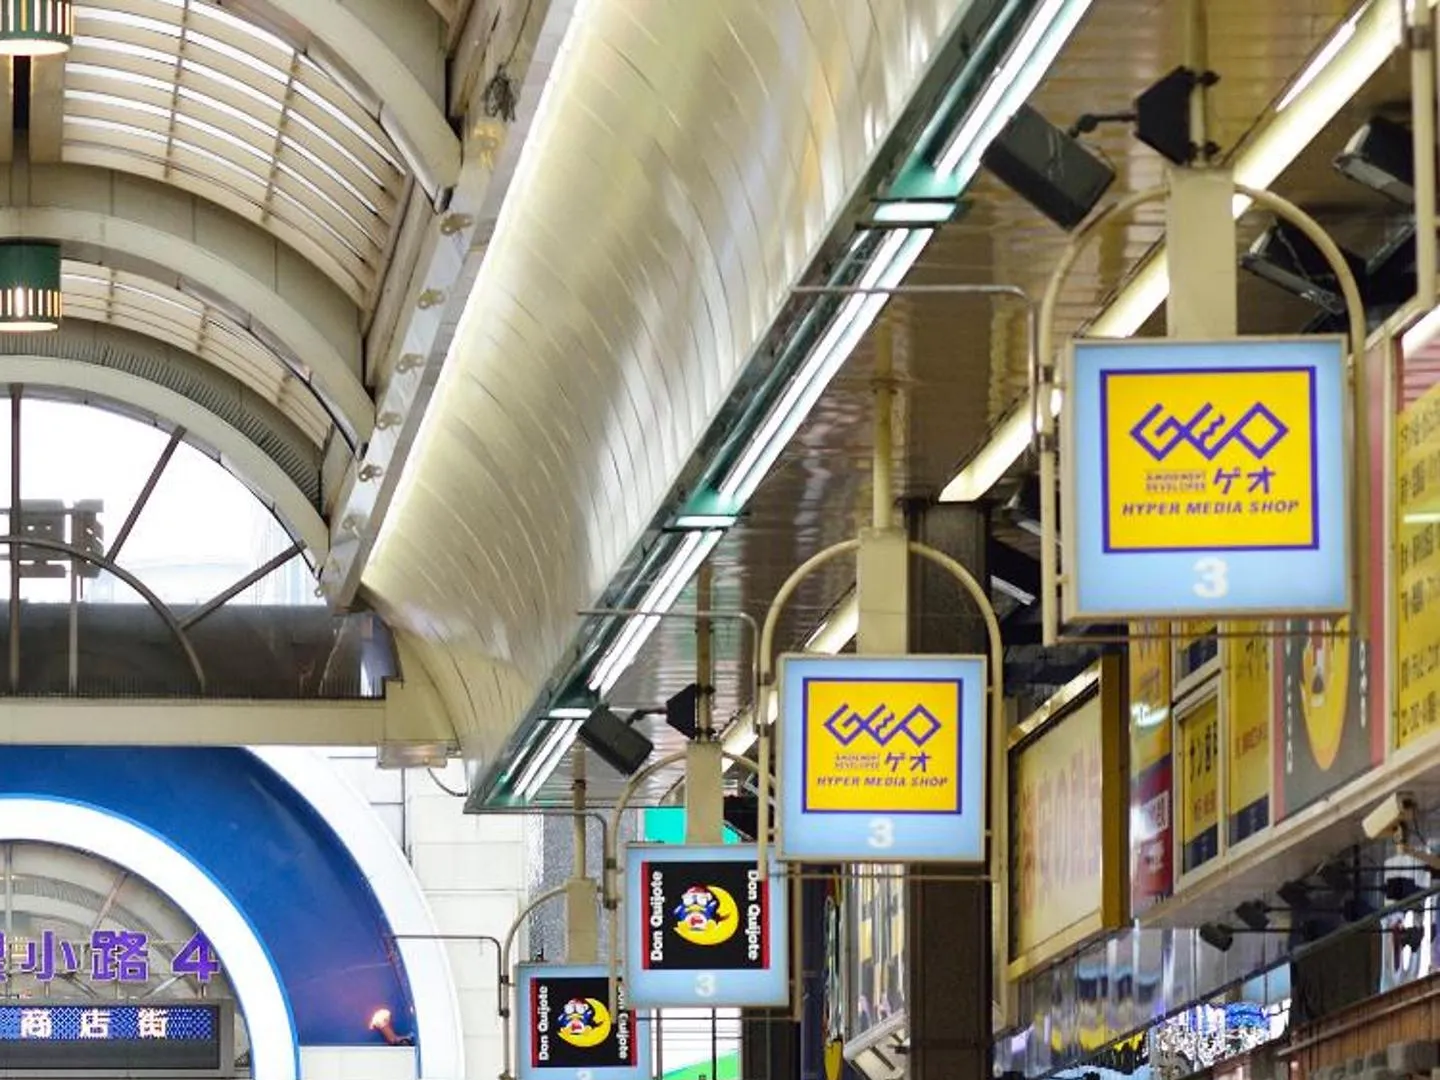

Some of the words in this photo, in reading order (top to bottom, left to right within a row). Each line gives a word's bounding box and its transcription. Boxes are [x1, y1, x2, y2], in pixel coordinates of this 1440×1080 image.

[1129, 400, 1290, 461] GEO
[1212, 465, 1277, 495] ゲオ
[1122, 502, 1181, 516] HYPER
[1185, 501, 1243, 515] MEDIA
[1248, 500, 1300, 514] SHOP
[1192, 556, 1229, 599] 3
[823, 702, 943, 748] GEO
[885, 751, 932, 773] ゲオ
[817, 776, 860, 787] HYPER
[864, 776, 906, 787] MEDIA
[911, 775, 949, 787] SHOP
[867, 816, 895, 848] 3
[650, 871, 665, 928] Quijote
[747, 870, 759, 901] Don
[650, 930, 664, 961] Don
[745, 903, 761, 961] Quijote
[694, 972, 715, 997] 3
[537, 985, 551, 1032] Quijote
[539, 1035, 549, 1061] Don
[616, 1012, 630, 1060] Quijote
